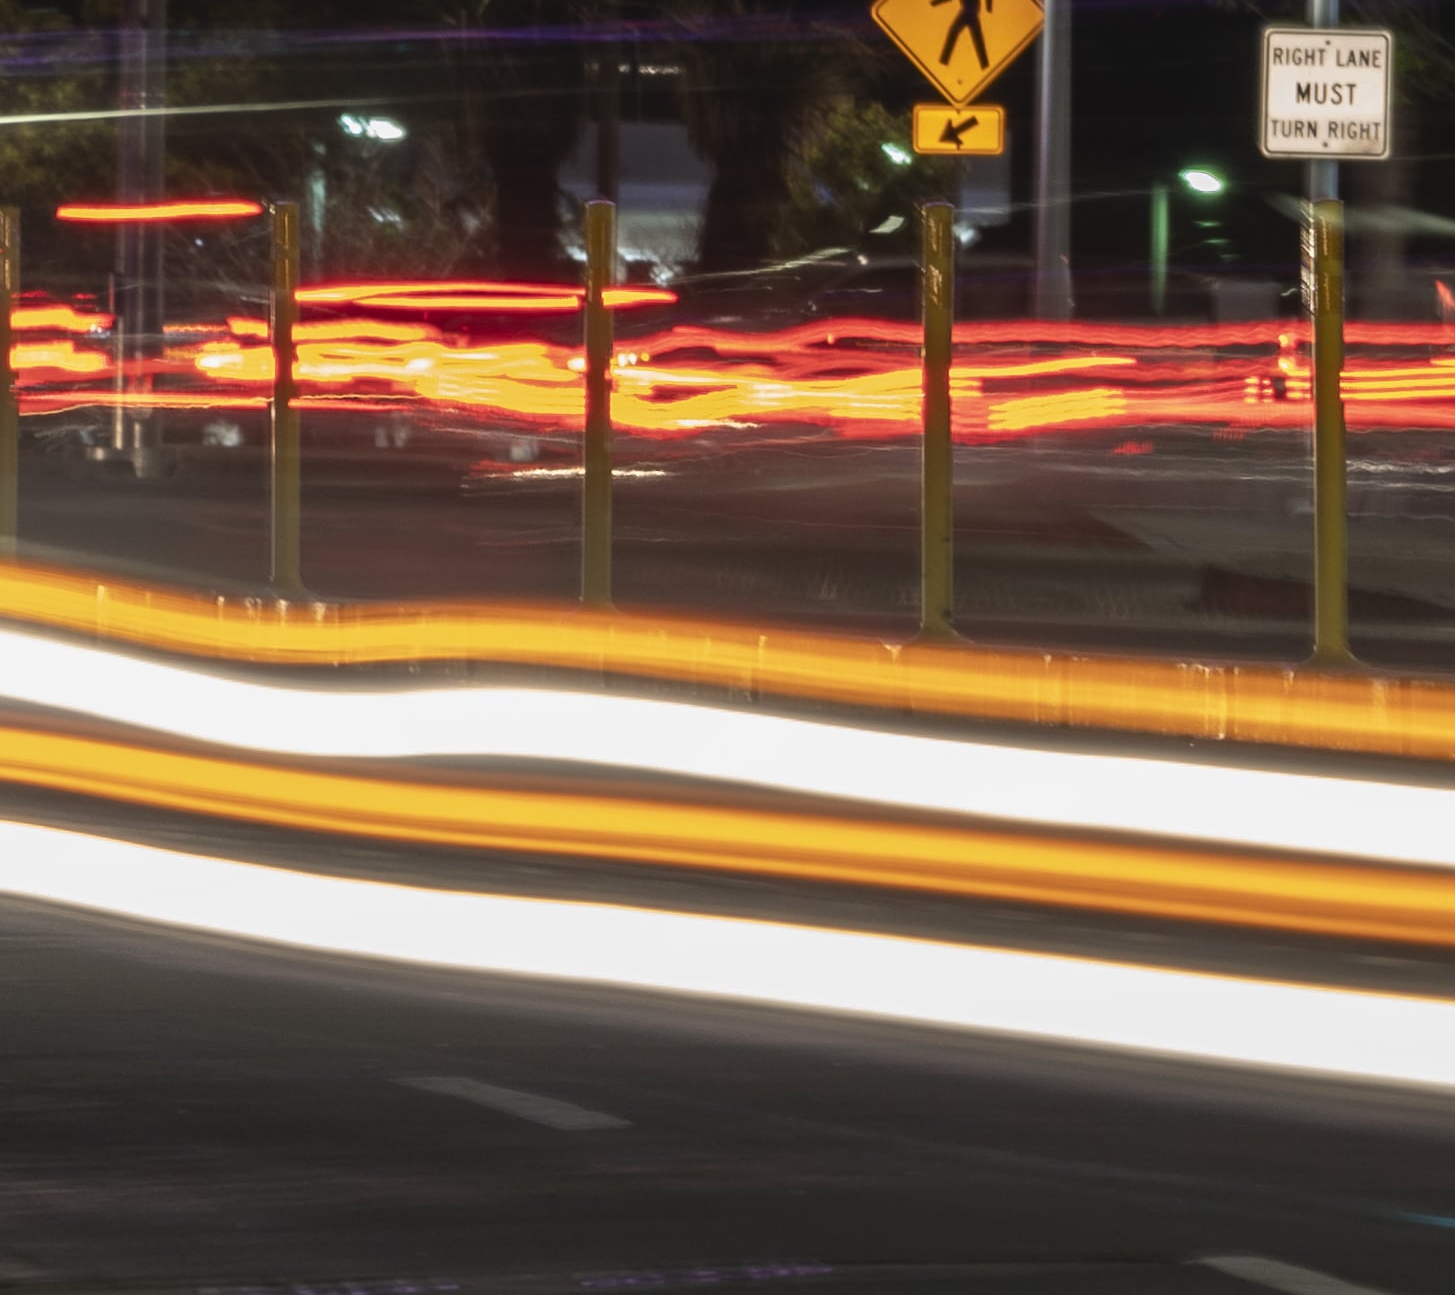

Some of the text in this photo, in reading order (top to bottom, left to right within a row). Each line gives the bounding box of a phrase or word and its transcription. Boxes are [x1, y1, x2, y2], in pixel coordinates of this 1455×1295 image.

[1272, 47, 1382, 68] RIGHT LANE
[1295, 82, 1357, 106] MUST
[1271, 119, 1382, 140] TURN RIGHT
